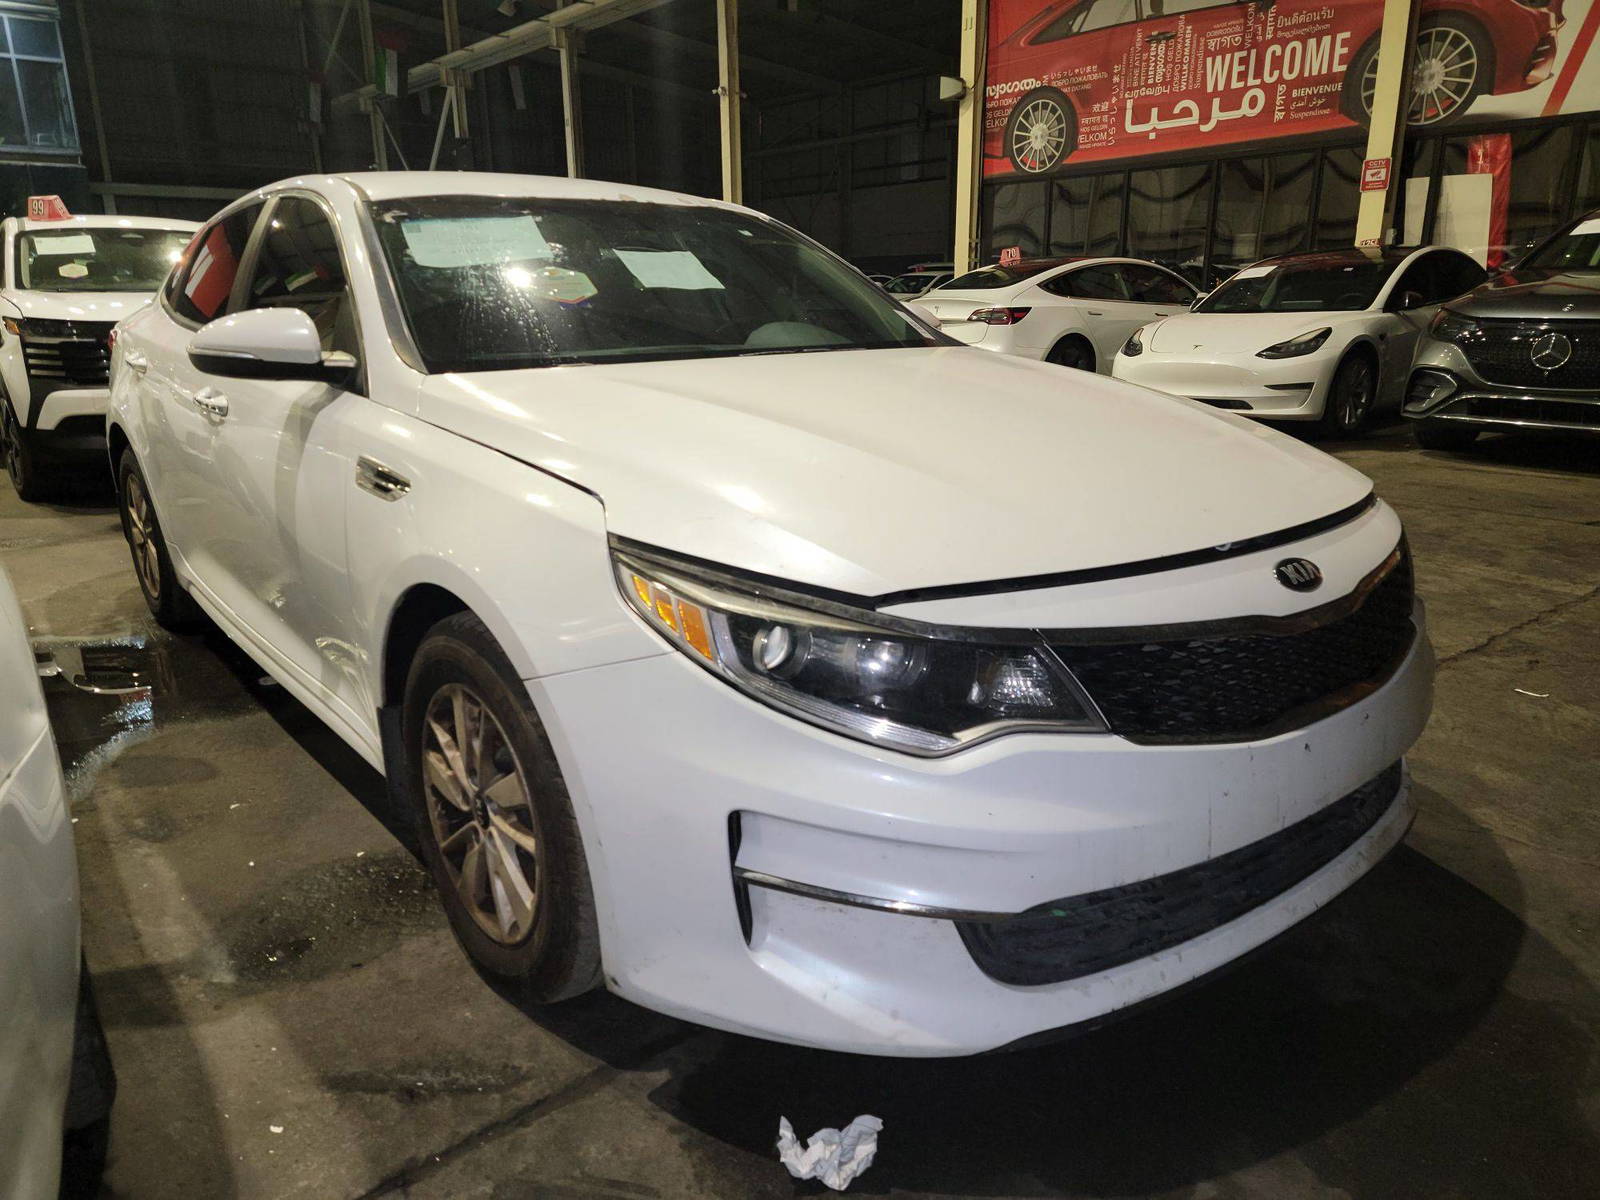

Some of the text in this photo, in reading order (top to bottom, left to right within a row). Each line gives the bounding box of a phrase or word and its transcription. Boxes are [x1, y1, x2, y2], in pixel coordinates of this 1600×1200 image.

[1180, 25, 1192, 91] WILLKOMMEN
[1206, 31, 1351, 93] WELCOME
[1292, 82, 1343, 98] BIENVENUE
[1125, 88, 1265, 140] مرحبا
[1078, 132, 1107, 143] ELKOM
[32, 199, 44, 215] 99
[1006, 247, 1016, 258] 70
